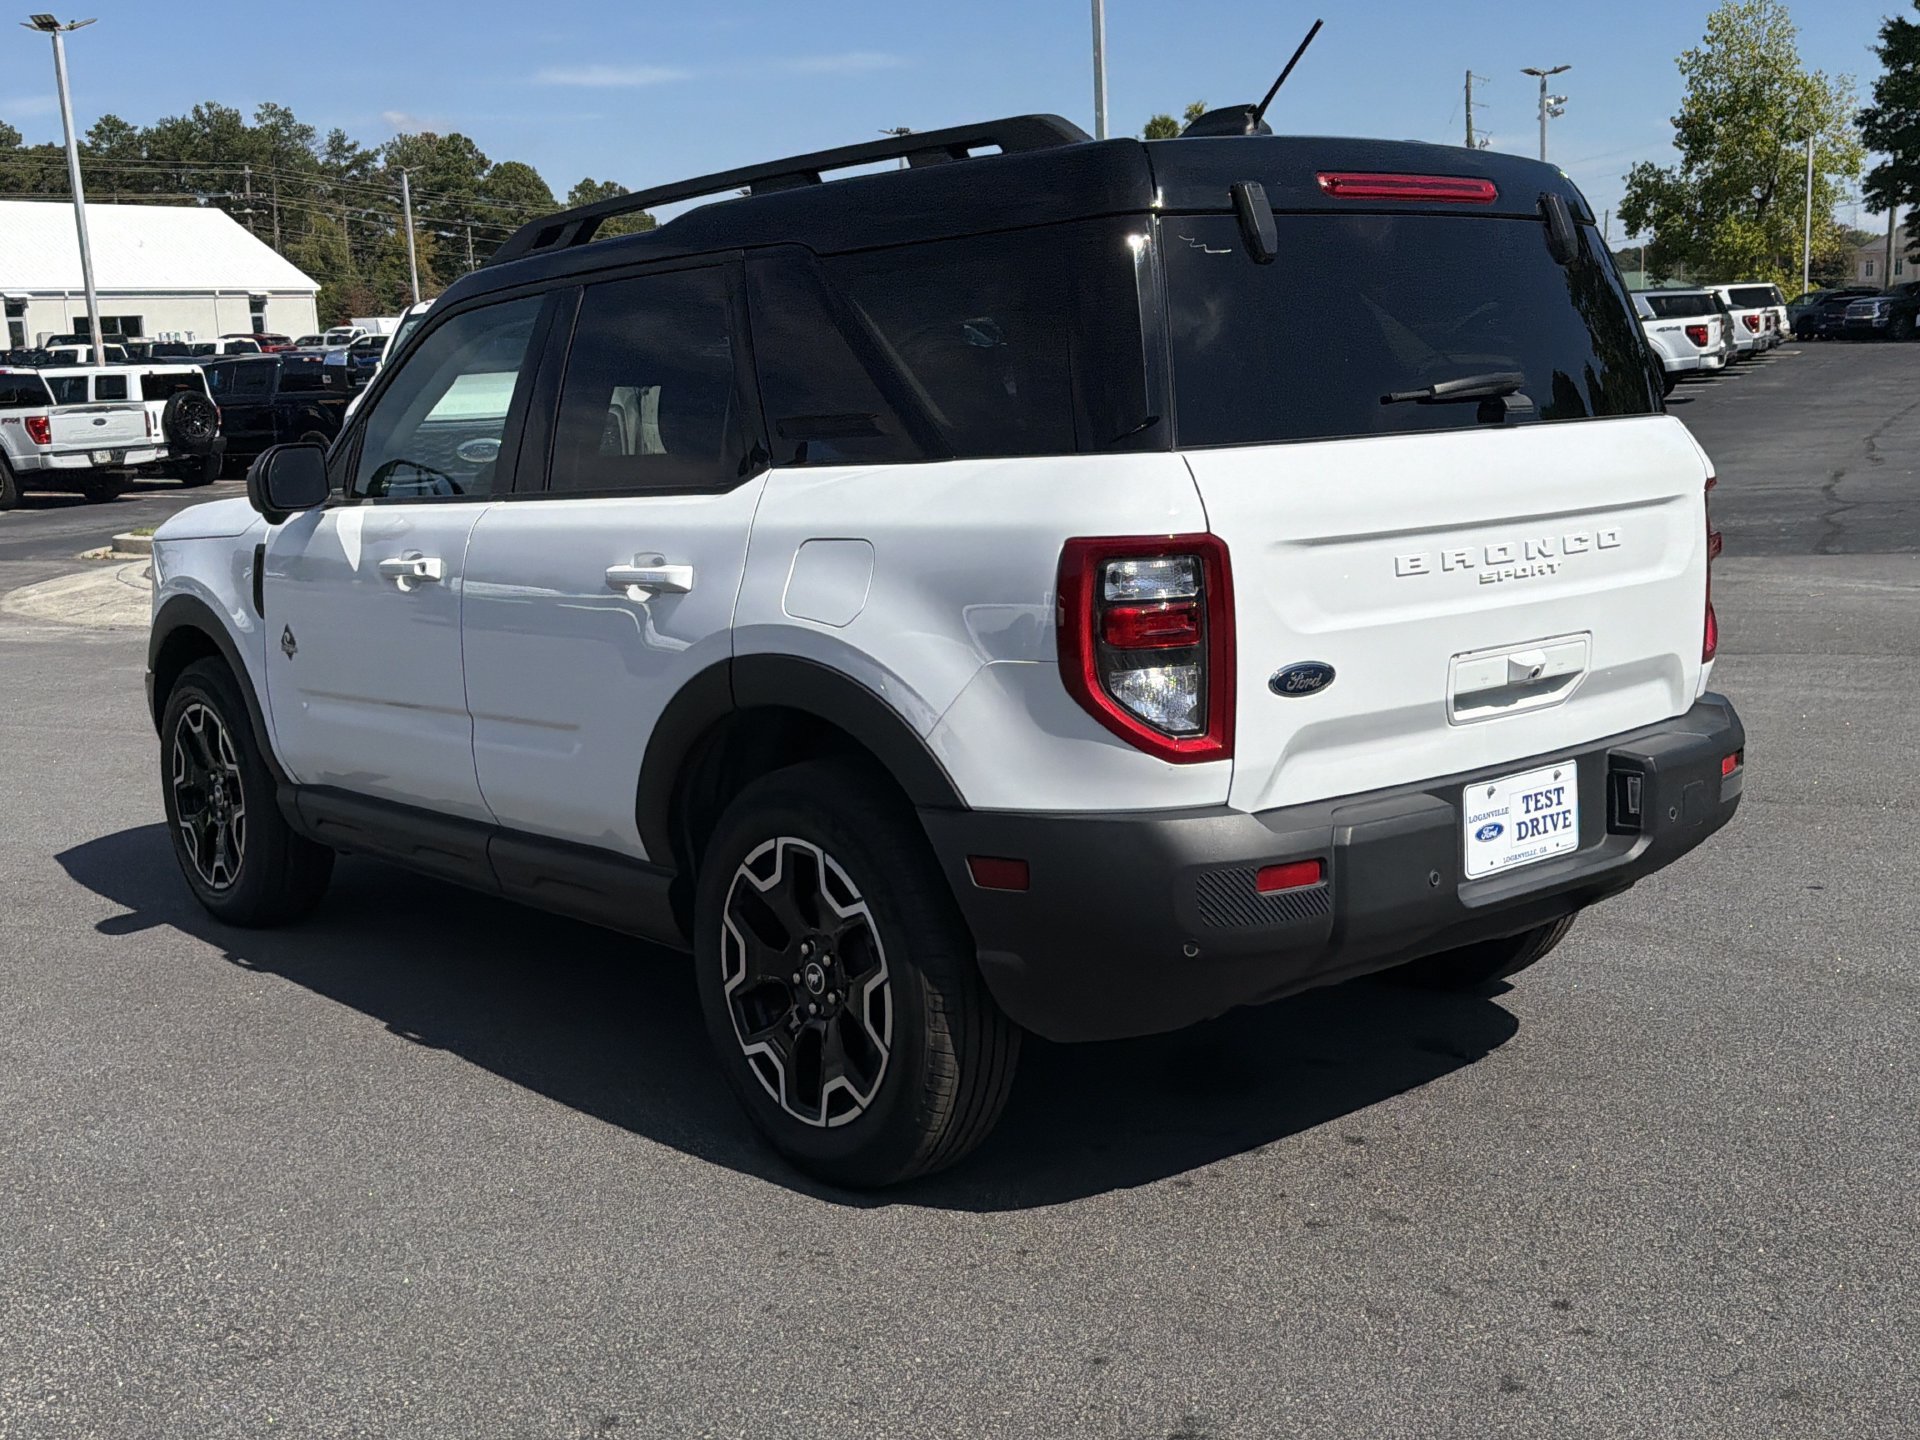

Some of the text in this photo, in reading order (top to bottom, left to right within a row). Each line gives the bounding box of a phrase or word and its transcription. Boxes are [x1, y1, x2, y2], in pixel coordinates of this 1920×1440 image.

[1395, 528, 1622, 577] BRONCO
[1479, 563, 1561, 585] SPORT
[1286, 669, 1323, 690] Ford
[1522, 786, 1565, 814] TEST
[1468, 807, 1510, 824] LOGANVILLE
[1516, 809, 1572, 841] DRIVE
[1480, 825, 1499, 840] Ford
